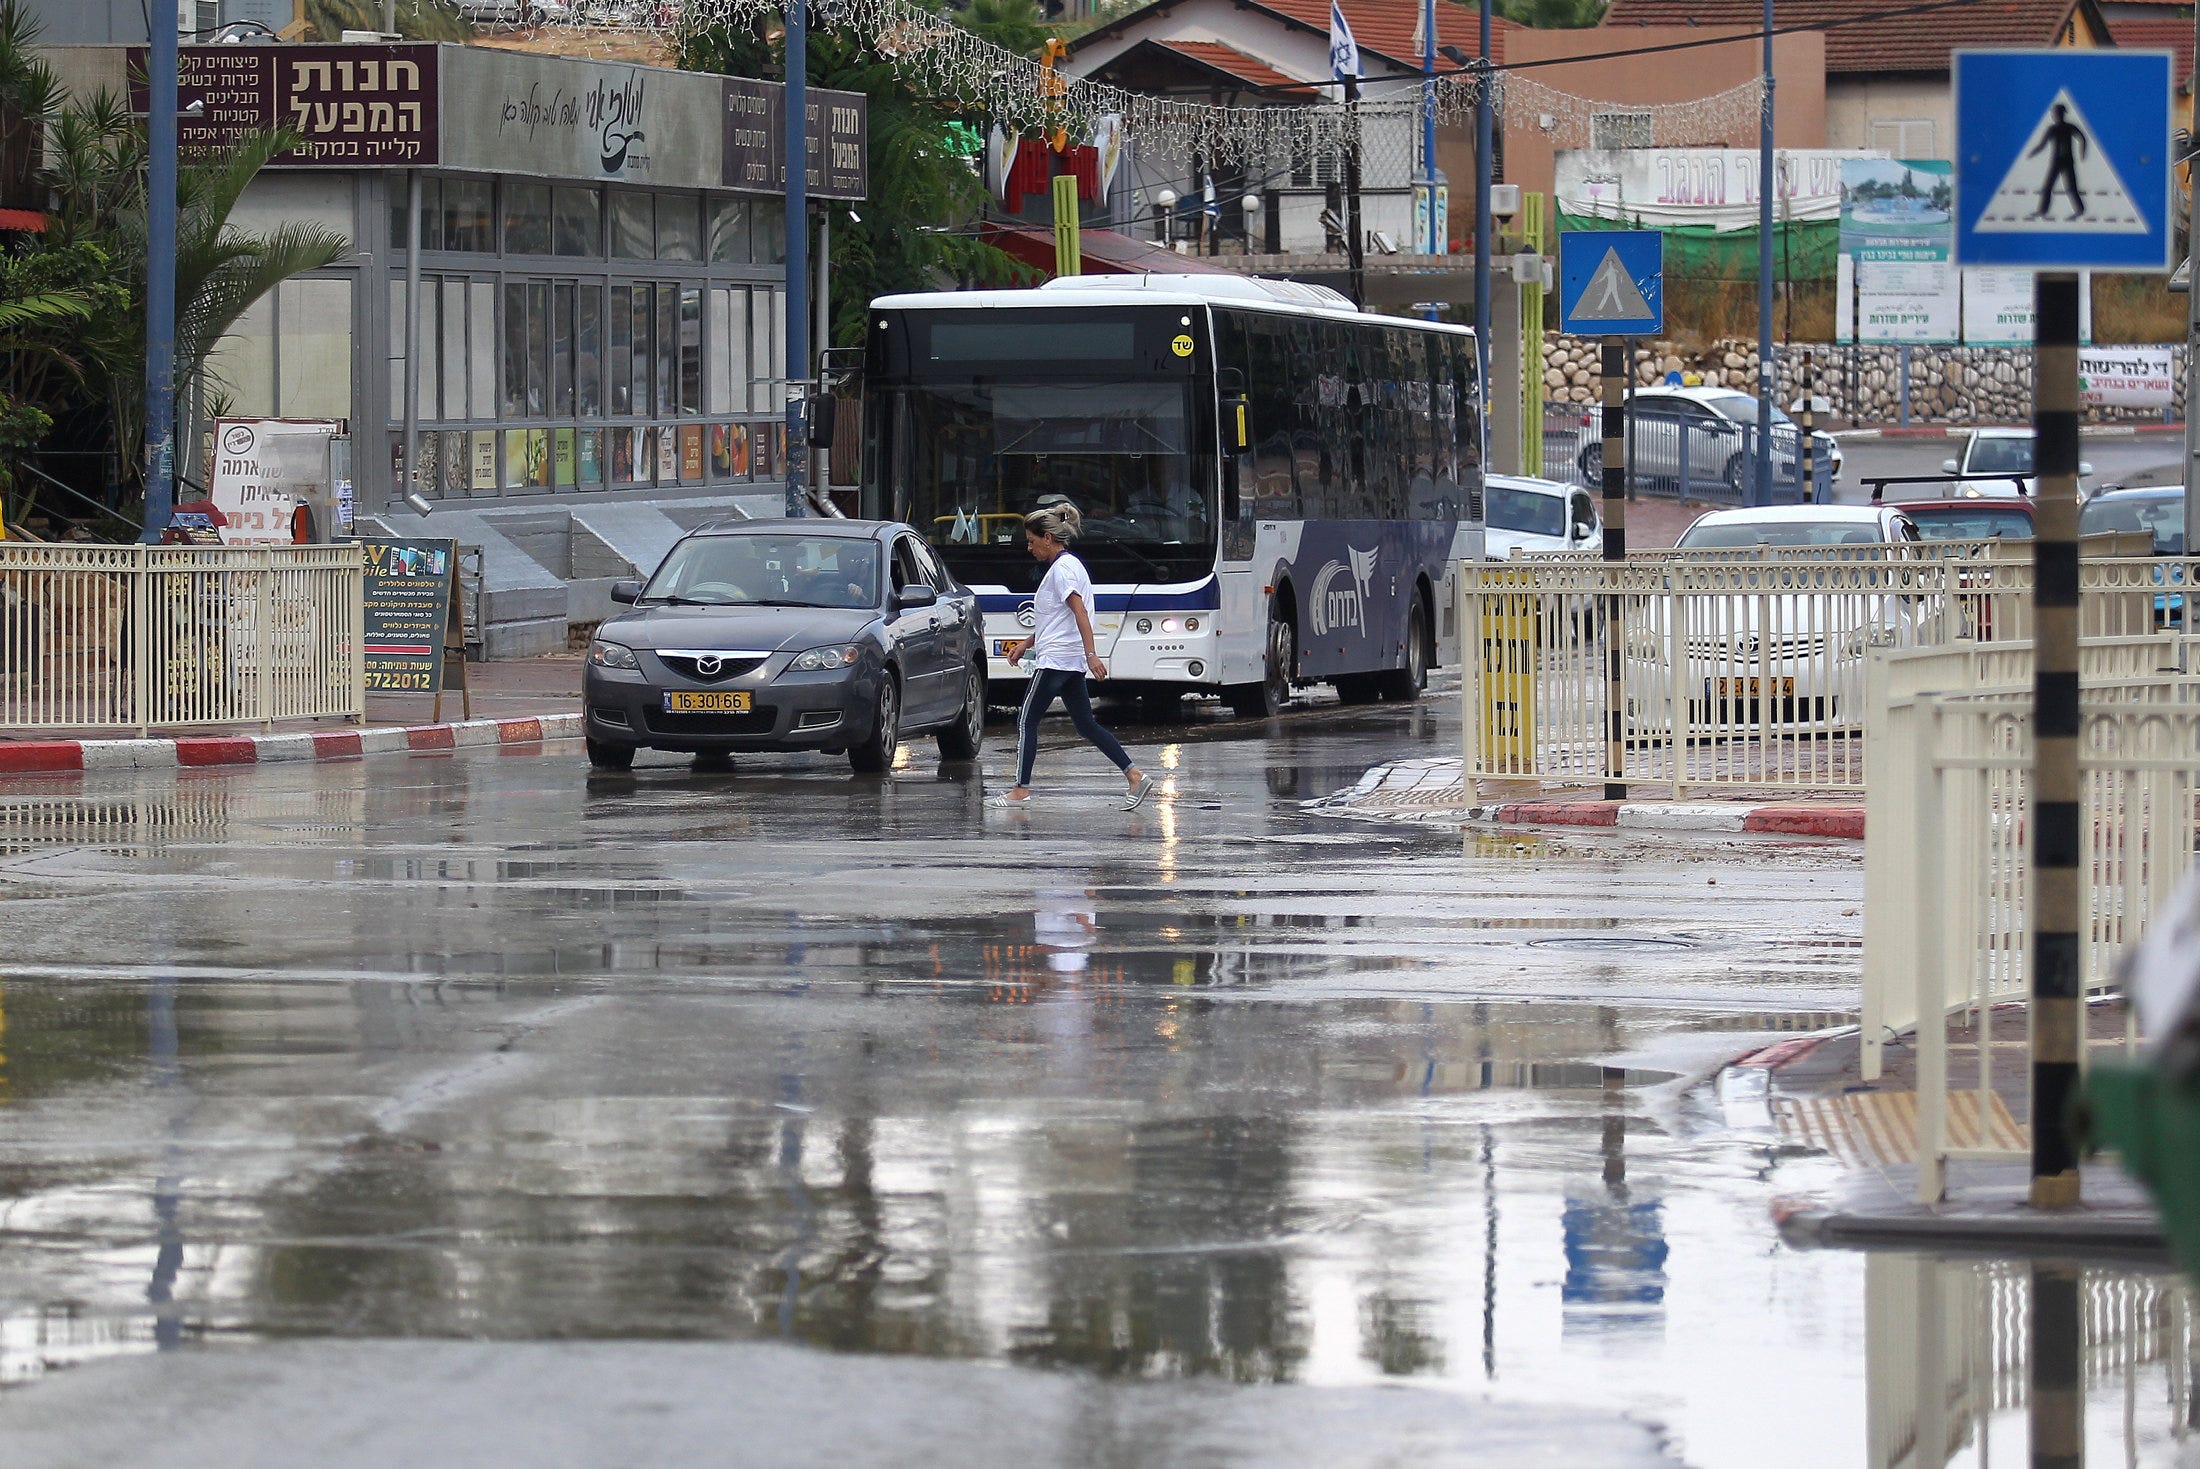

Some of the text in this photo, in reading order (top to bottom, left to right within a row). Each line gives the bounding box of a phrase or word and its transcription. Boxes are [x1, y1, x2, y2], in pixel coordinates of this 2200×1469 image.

[206, 56, 259, 68] פיצוחים
[221, 74, 259, 86] פירות
[292, 61, 420, 91] חנות
[206, 89, 259, 104] תבלינים
[213, 109, 259, 124] קטניות
[290, 96, 421, 132] המפעל
[832, 106, 859, 134] חנות
[183, 127, 217, 139] אפיה
[293, 138, 420, 159] קלייה במקום
[831, 135, 860, 169] המפעל
[1173, 341, 1193, 350] שד
[2153, 361, 2168, 375] די
[410, 662, 433, 670] שעות
